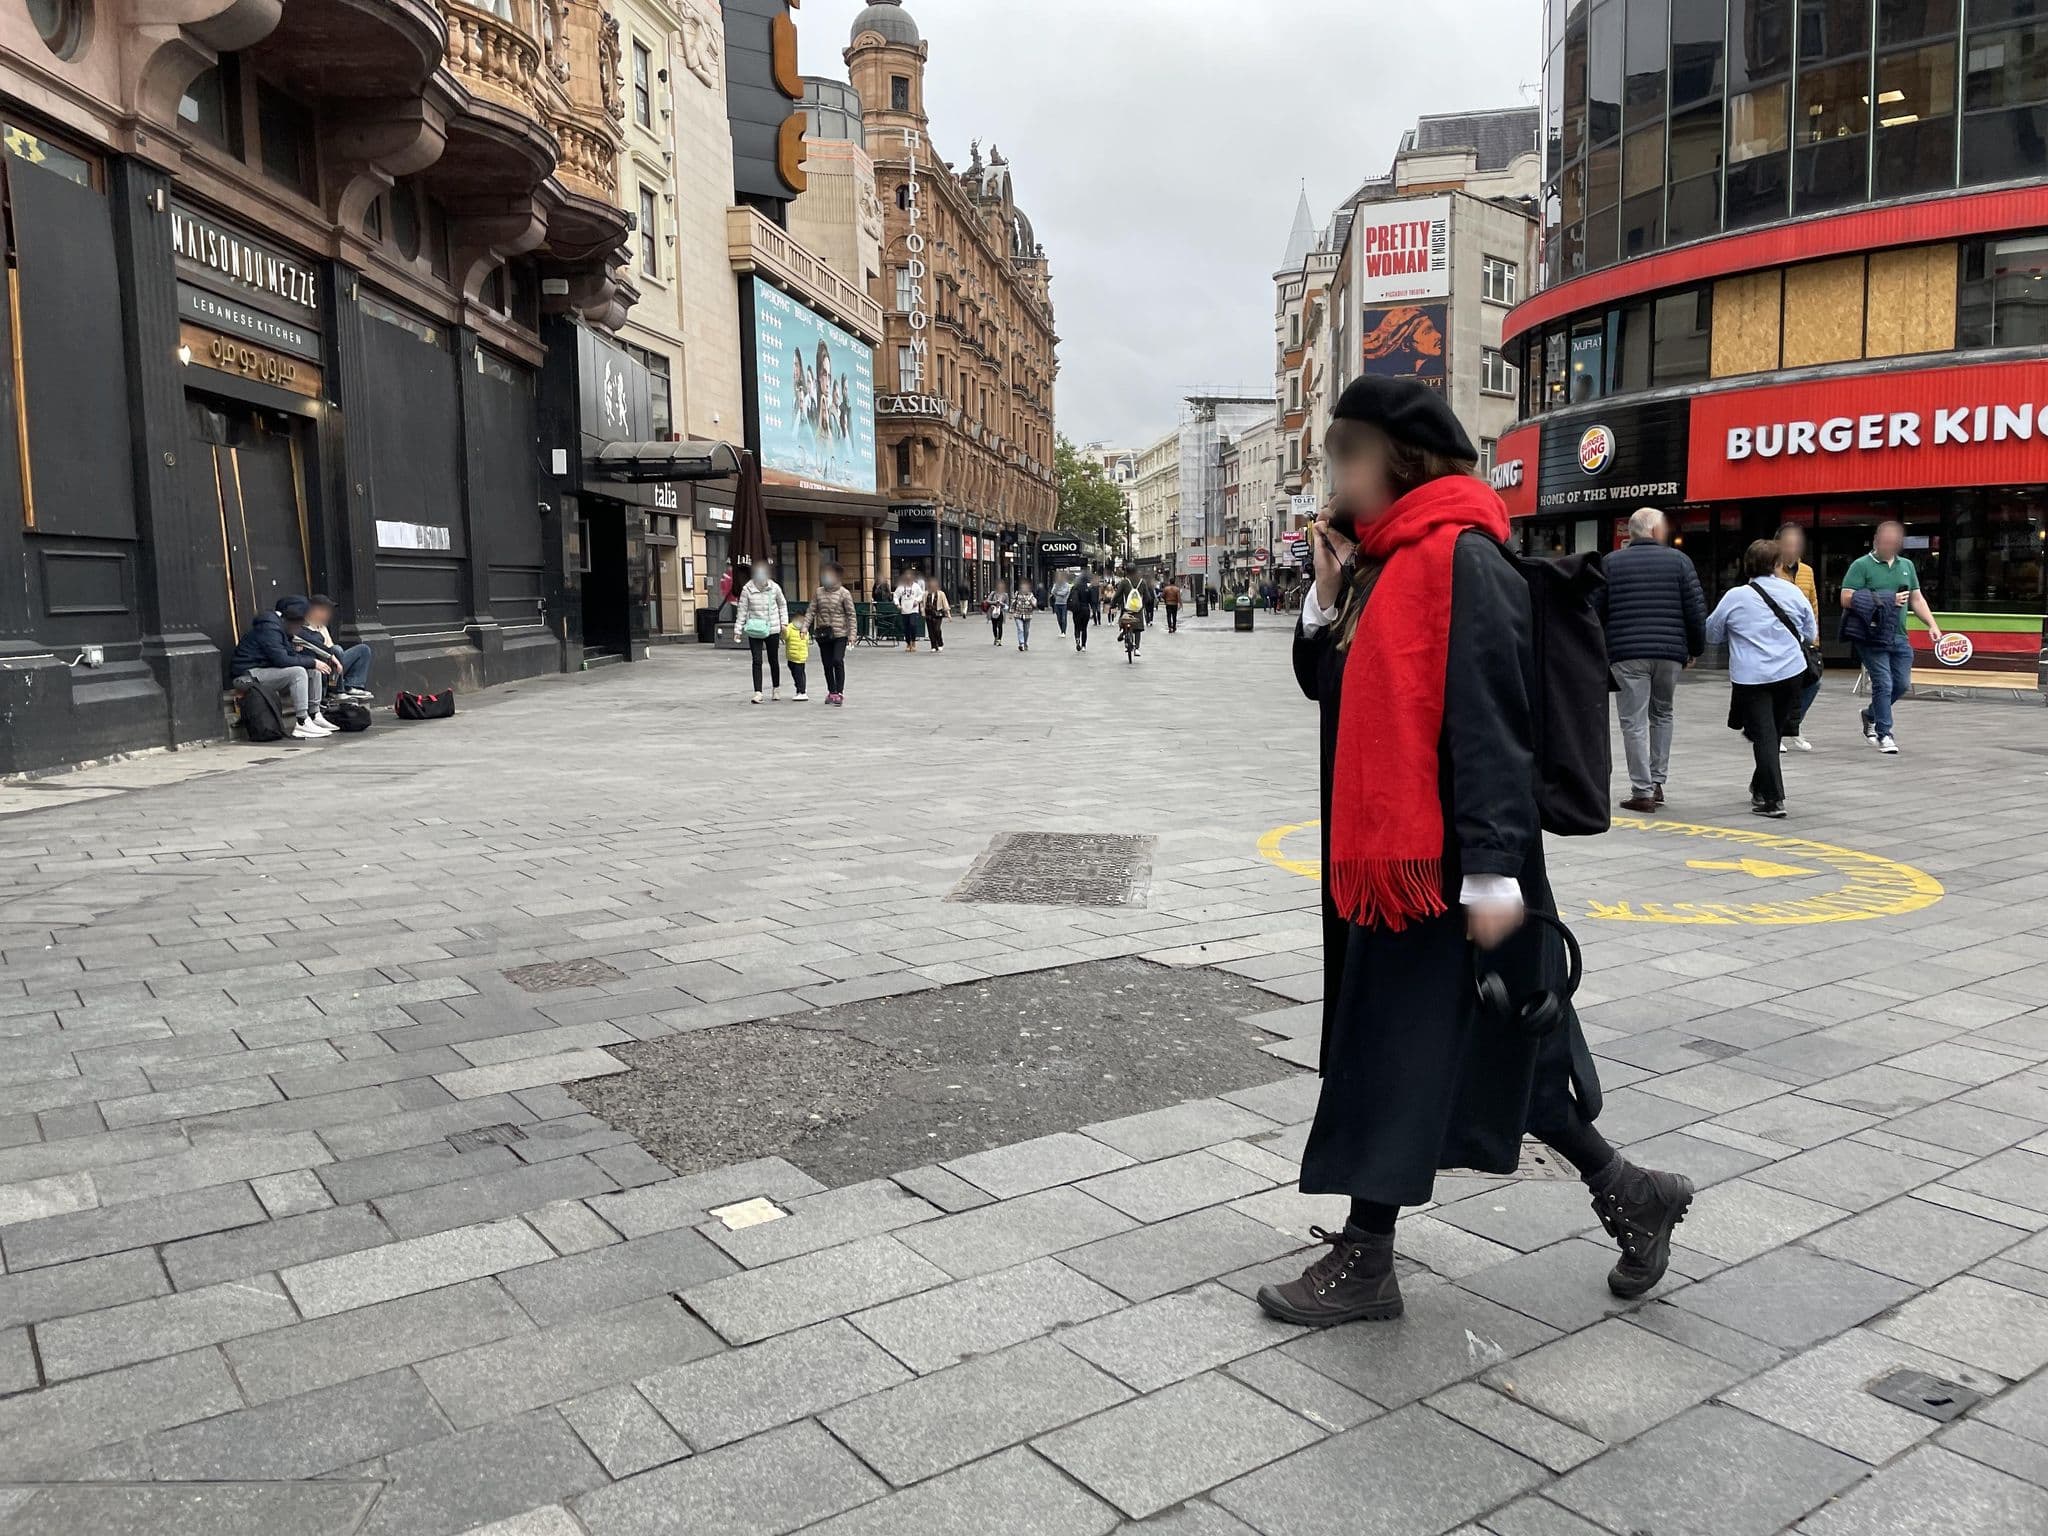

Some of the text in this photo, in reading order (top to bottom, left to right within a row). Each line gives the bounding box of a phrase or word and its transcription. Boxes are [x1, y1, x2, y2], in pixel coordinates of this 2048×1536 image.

[1366, 220, 1431, 253] PRETTY
[1431, 219, 1446, 272] THE MUSICAL
[171, 213, 317, 309] MAISON DU MEZZÉ
[903, 128, 928, 381] HIPPODROME
[1366, 249, 1428, 277] WOMAN
[193, 296, 301, 345] LEBANESE KITCHEN
[875, 395, 948, 416] CASINO
[1581, 434, 1605, 452] BURGER
[1727, 411, 1921, 461] BURGER
[1582, 442, 1606, 464] KING
[654, 482, 678, 508] talia
[1540, 482, 1678, 507] HOME OF THE WHOPPER
[1042, 543, 1077, 552] CASINO
[1940, 639, 1968, 650] BURGER
[1941, 644, 1968, 657] KING
